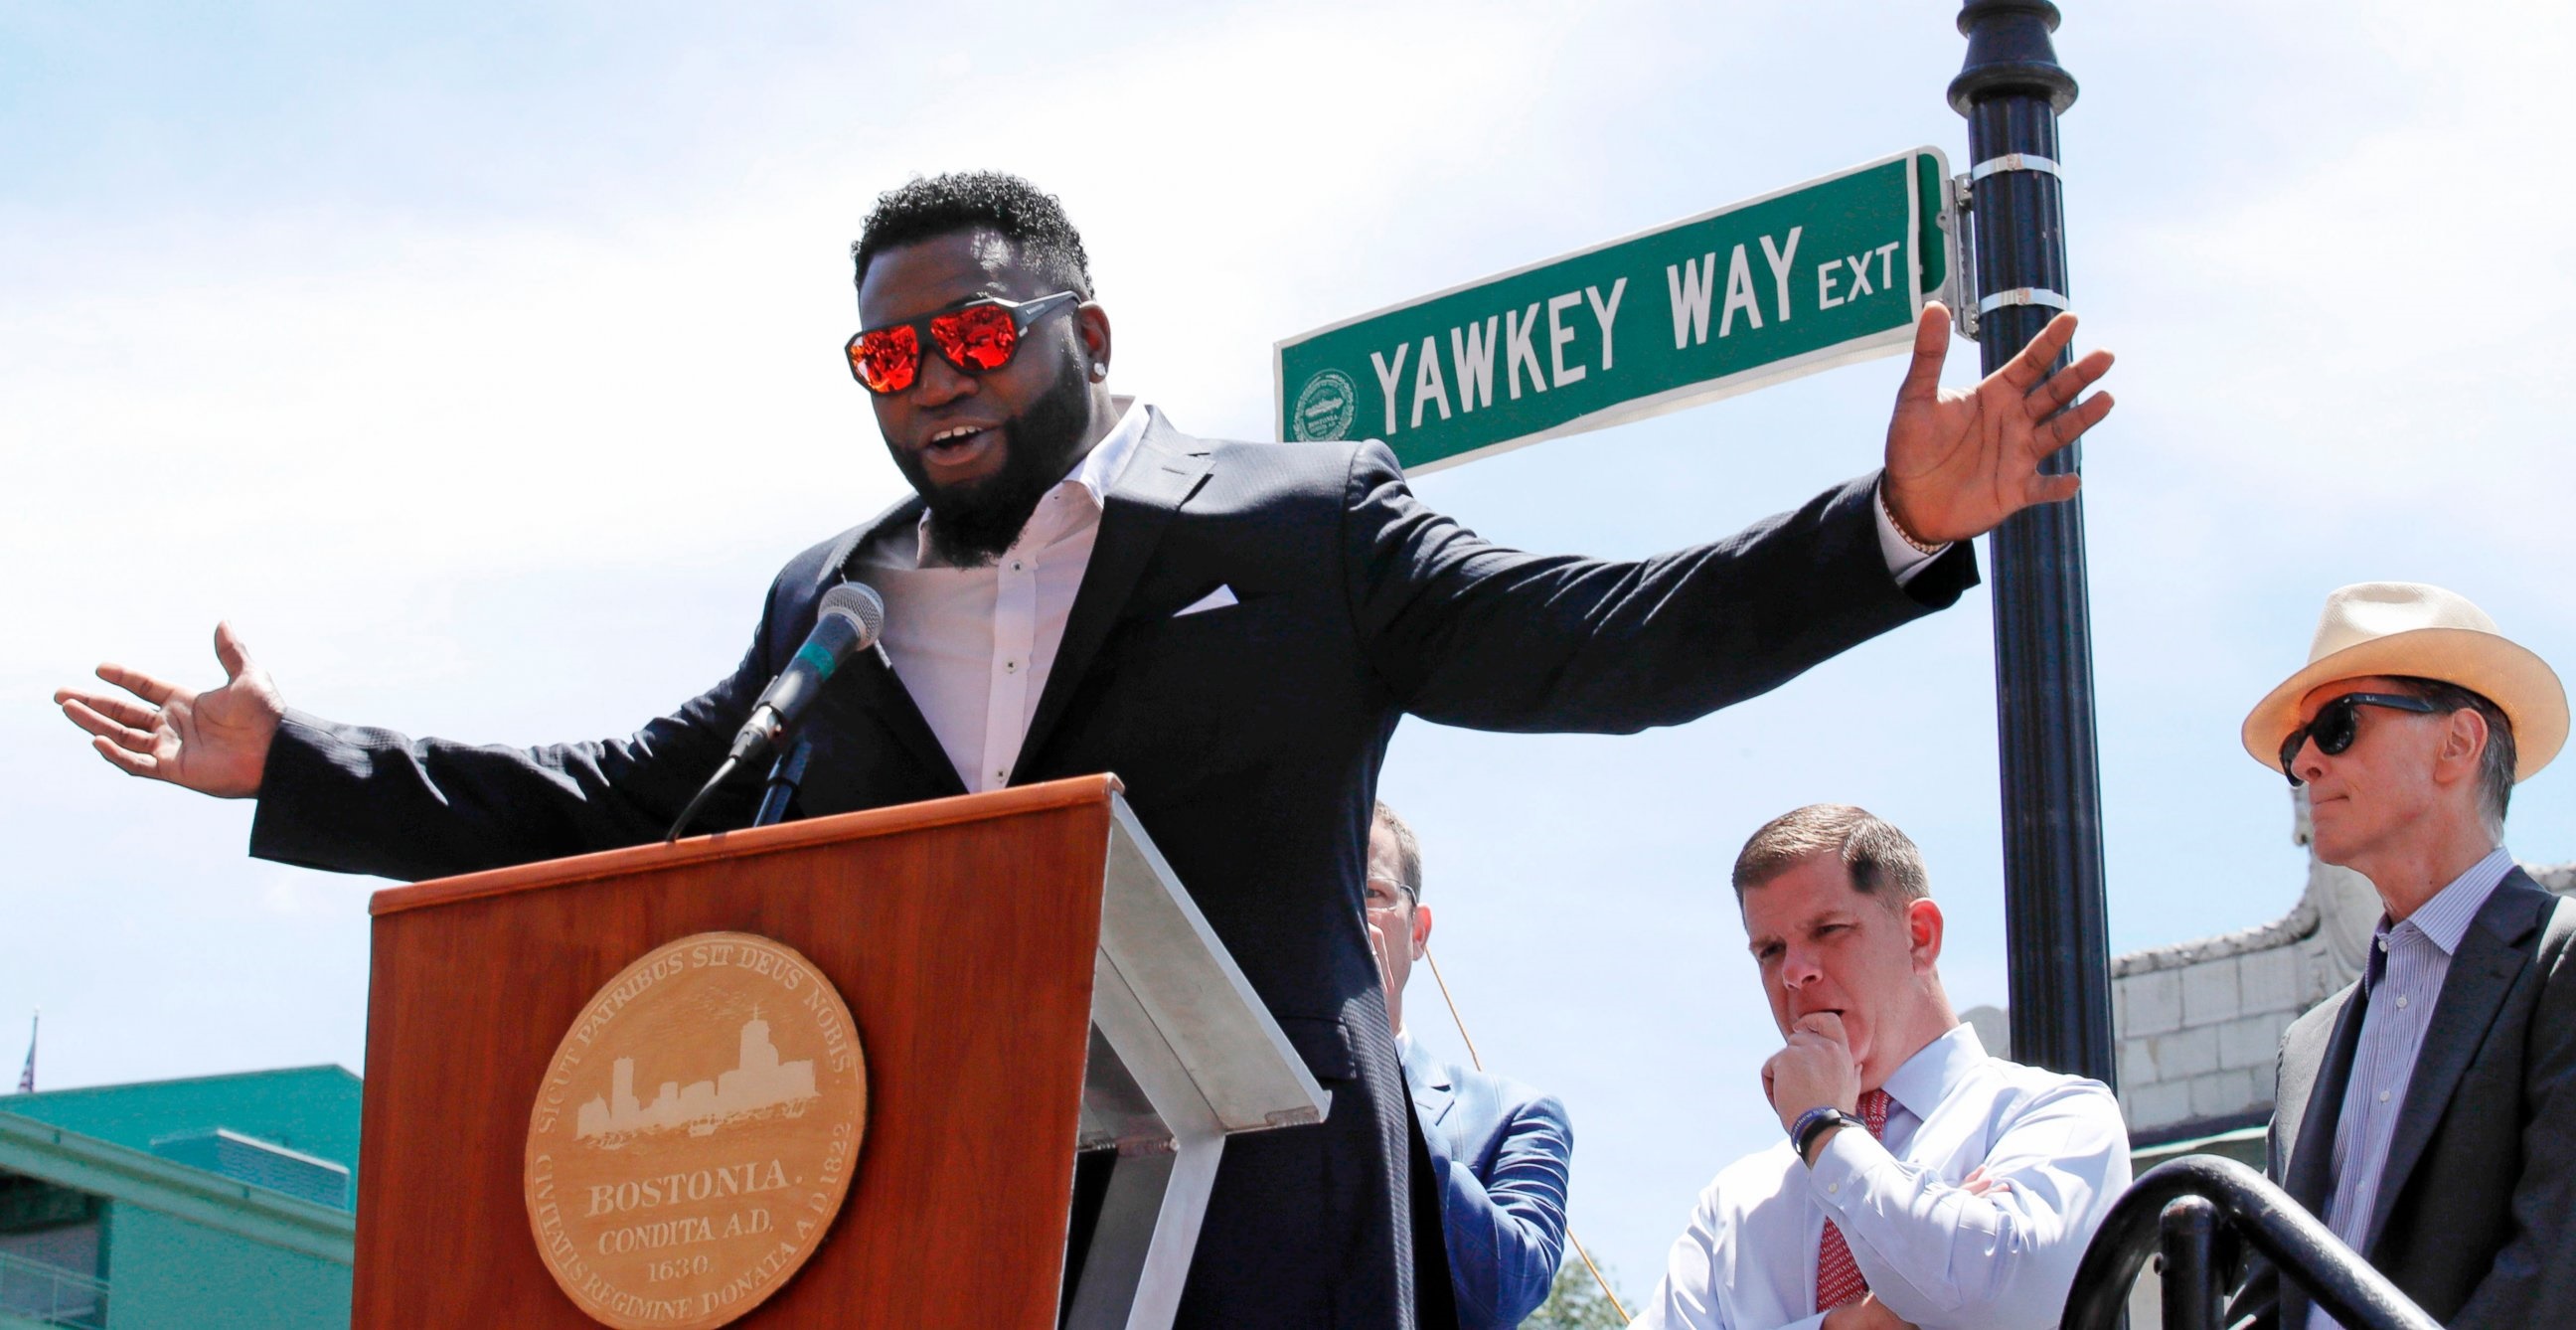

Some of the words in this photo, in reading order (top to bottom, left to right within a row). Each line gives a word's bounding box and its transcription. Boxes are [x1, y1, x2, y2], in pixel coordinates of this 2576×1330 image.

[1370, 277, 1628, 435] YAWKEY
[1667, 226, 1802, 350] WAY
[1818, 242, 1900, 311] EXT
[539, 1047, 581, 1133] SICUT
[575, 951, 684, 1045] PATRIBUS
[693, 945, 733, 969] SIT
[736, 947, 804, 990] DEUS
[803, 987, 851, 1074] NOBIS
[536, 1154, 588, 1281] CIVITATIS
[582, 1272, 693, 1321] REGIMINE
[702, 1243, 796, 1316] DONATA
[820, 1122, 852, 1185] 1822
[598, 1216, 716, 1255] CONDITA
